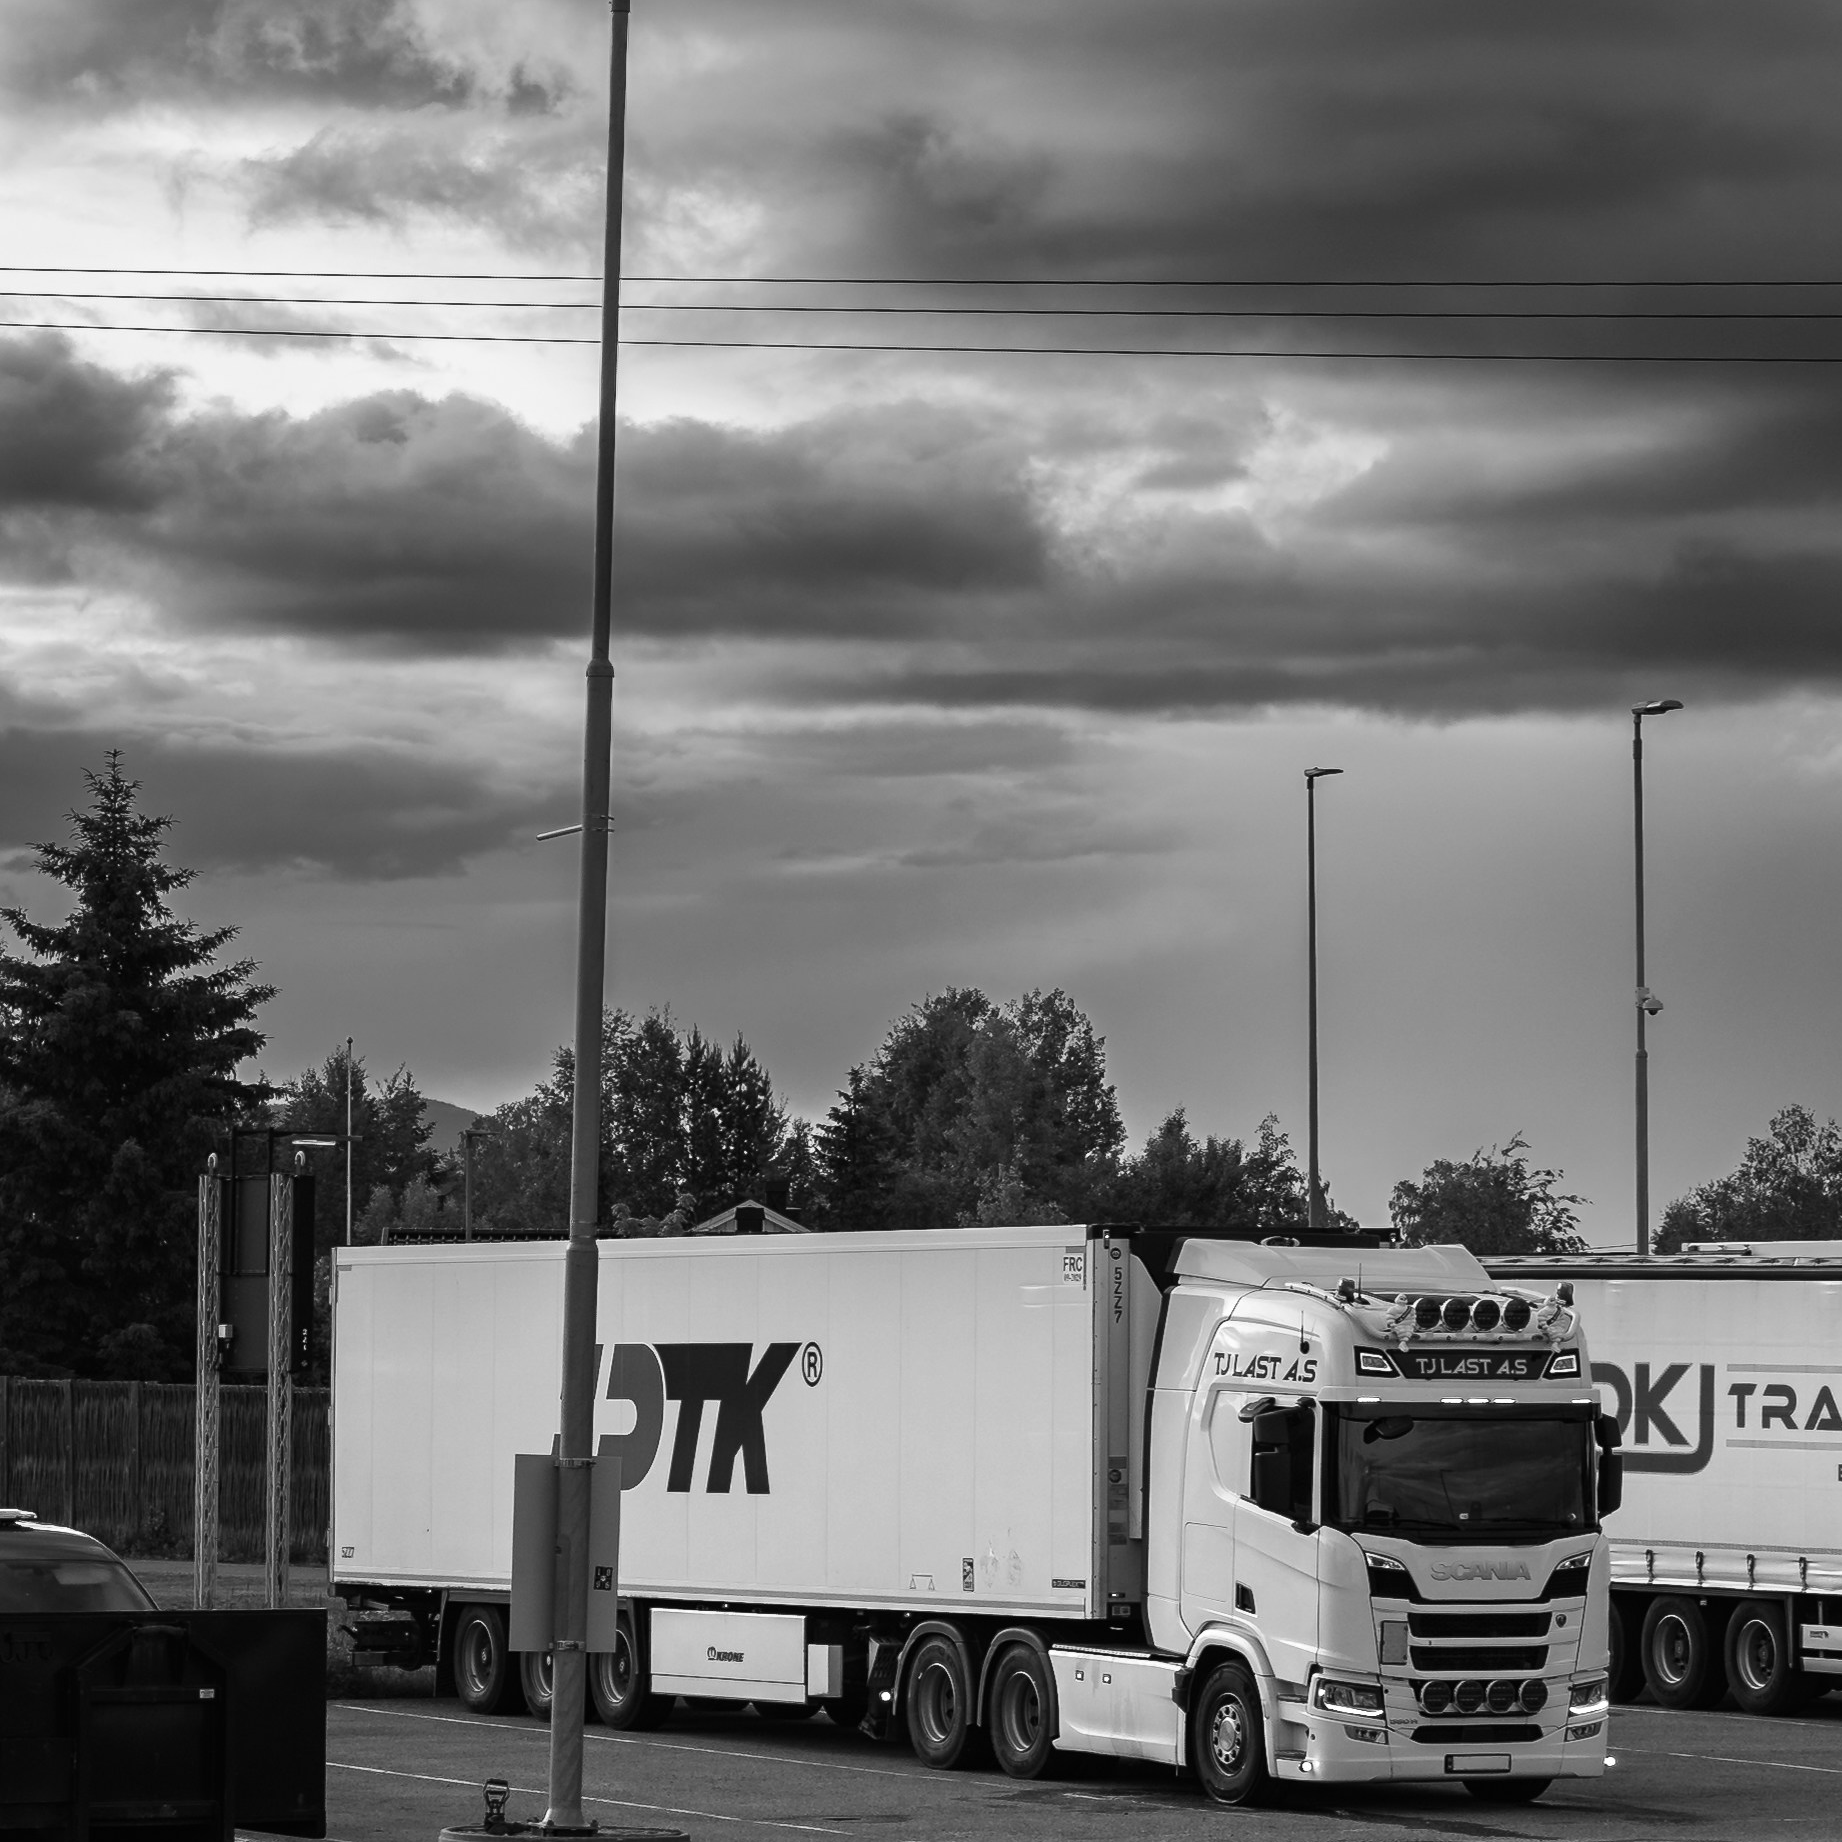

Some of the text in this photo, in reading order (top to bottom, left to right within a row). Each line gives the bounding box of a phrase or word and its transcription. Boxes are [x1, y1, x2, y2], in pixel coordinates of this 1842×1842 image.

[1063, 1256, 1083, 1272] FRC
[1232, 1354, 1282, 1379] LAST
[1440, 1358, 1491, 1374] LAST
[1430, 1560, 1532, 1581] SCANIA
